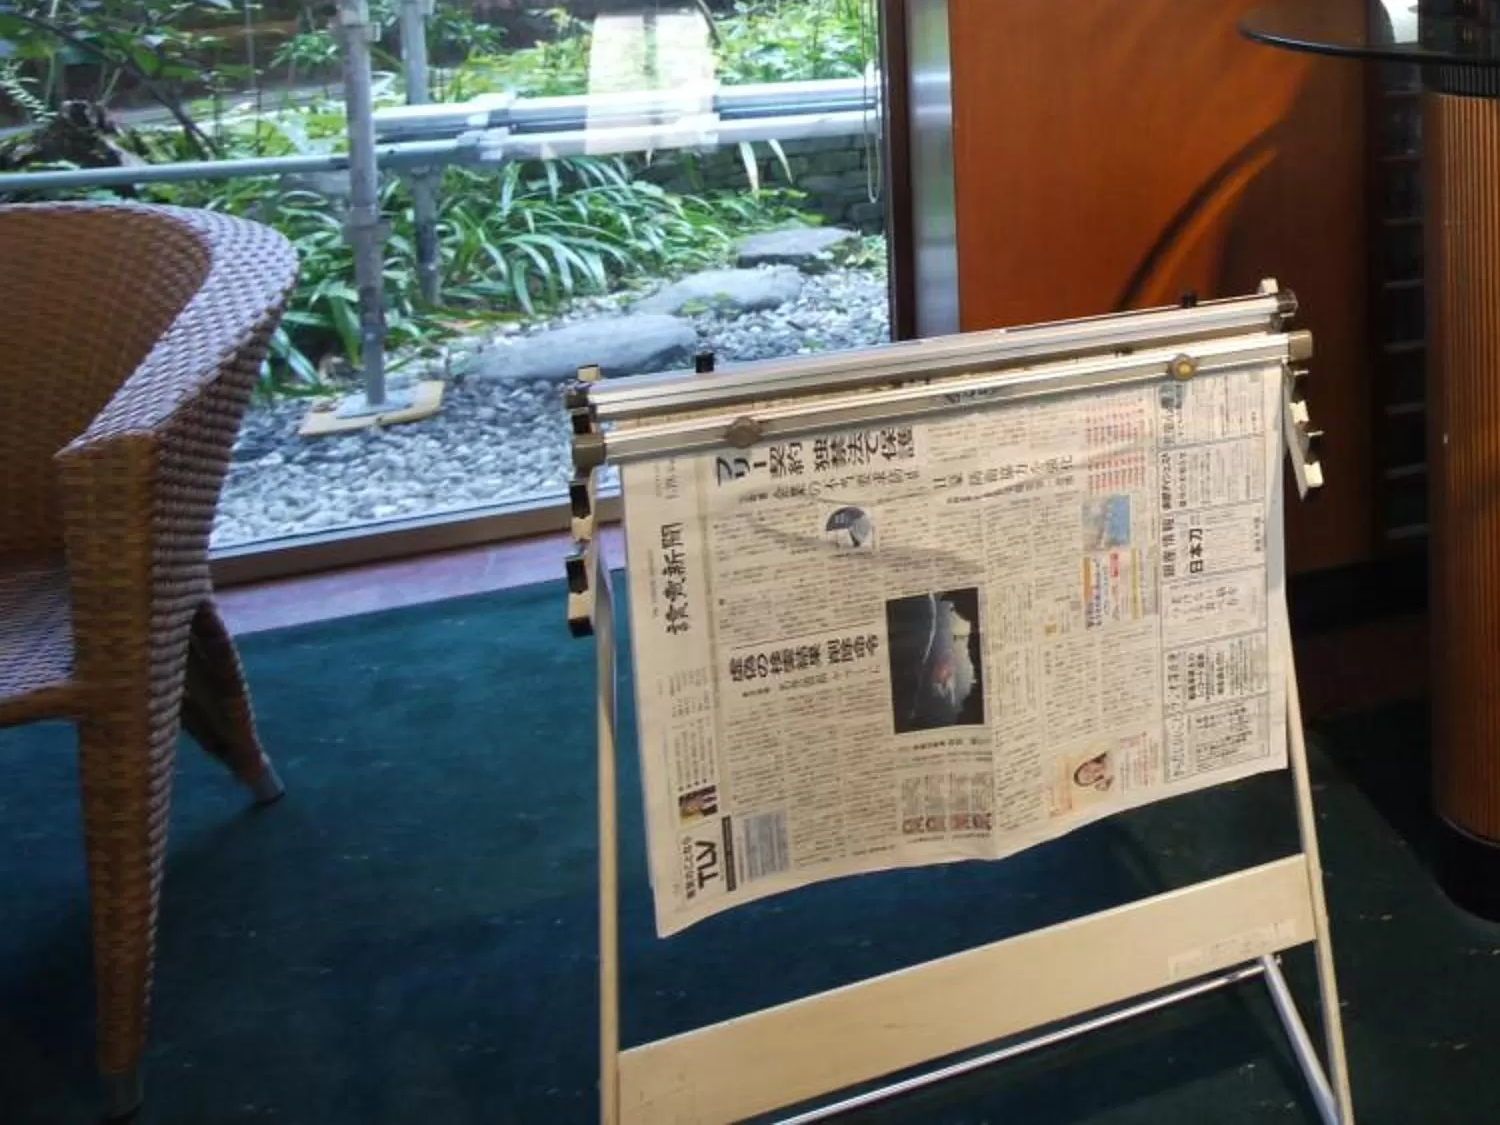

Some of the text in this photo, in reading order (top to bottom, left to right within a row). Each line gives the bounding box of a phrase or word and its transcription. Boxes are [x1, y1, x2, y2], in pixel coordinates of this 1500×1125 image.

[1190, 528, 1204, 573] 日本刀
[695, 840, 719, 889] TLV
